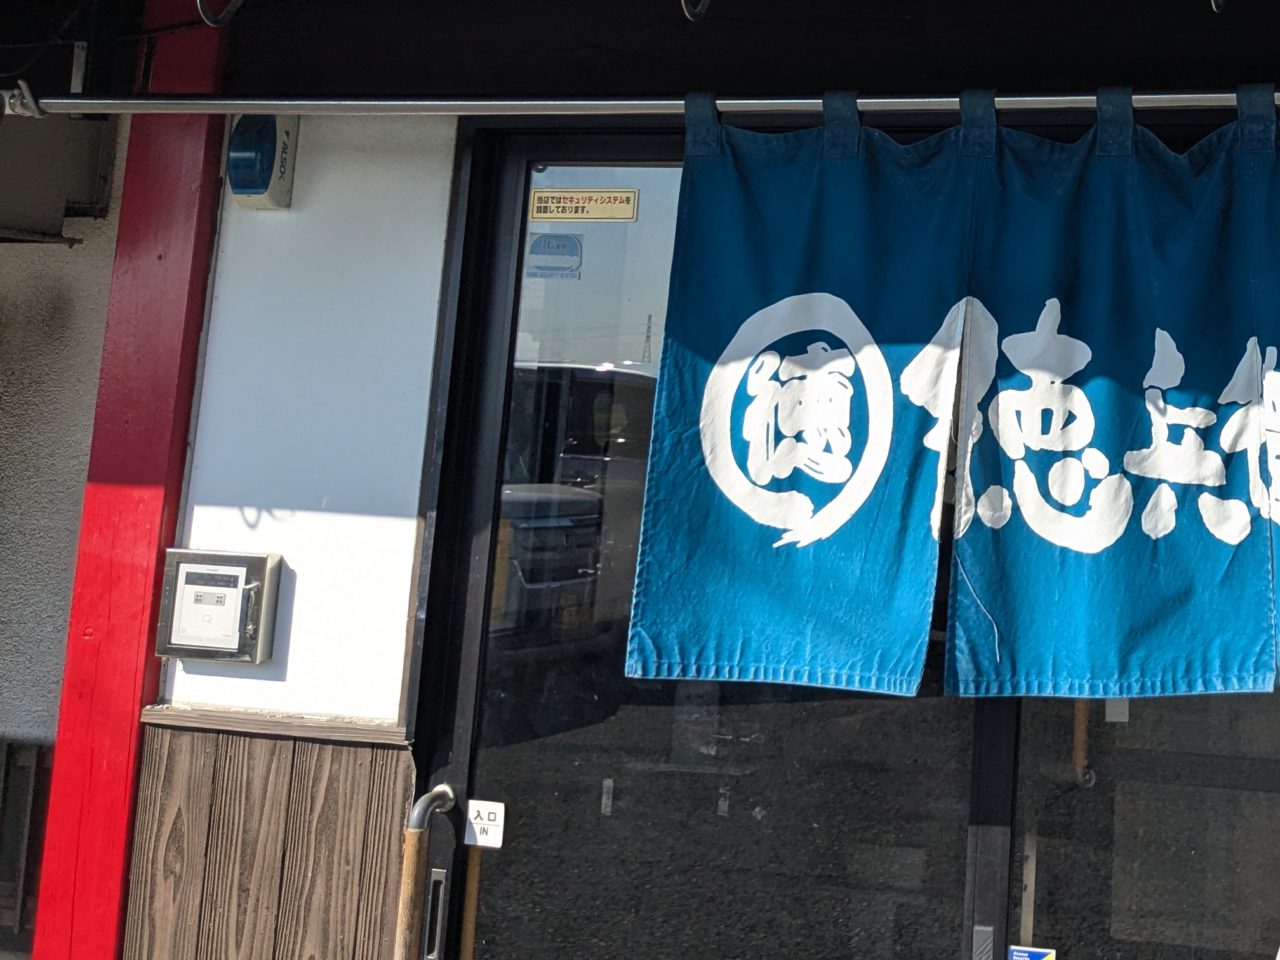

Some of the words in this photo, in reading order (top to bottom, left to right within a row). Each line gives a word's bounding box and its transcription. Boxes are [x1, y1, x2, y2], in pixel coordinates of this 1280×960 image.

[279, 141, 288, 181] ALSOK
[474, 810, 497, 822] 入口
[480, 826, 489, 836] IN
